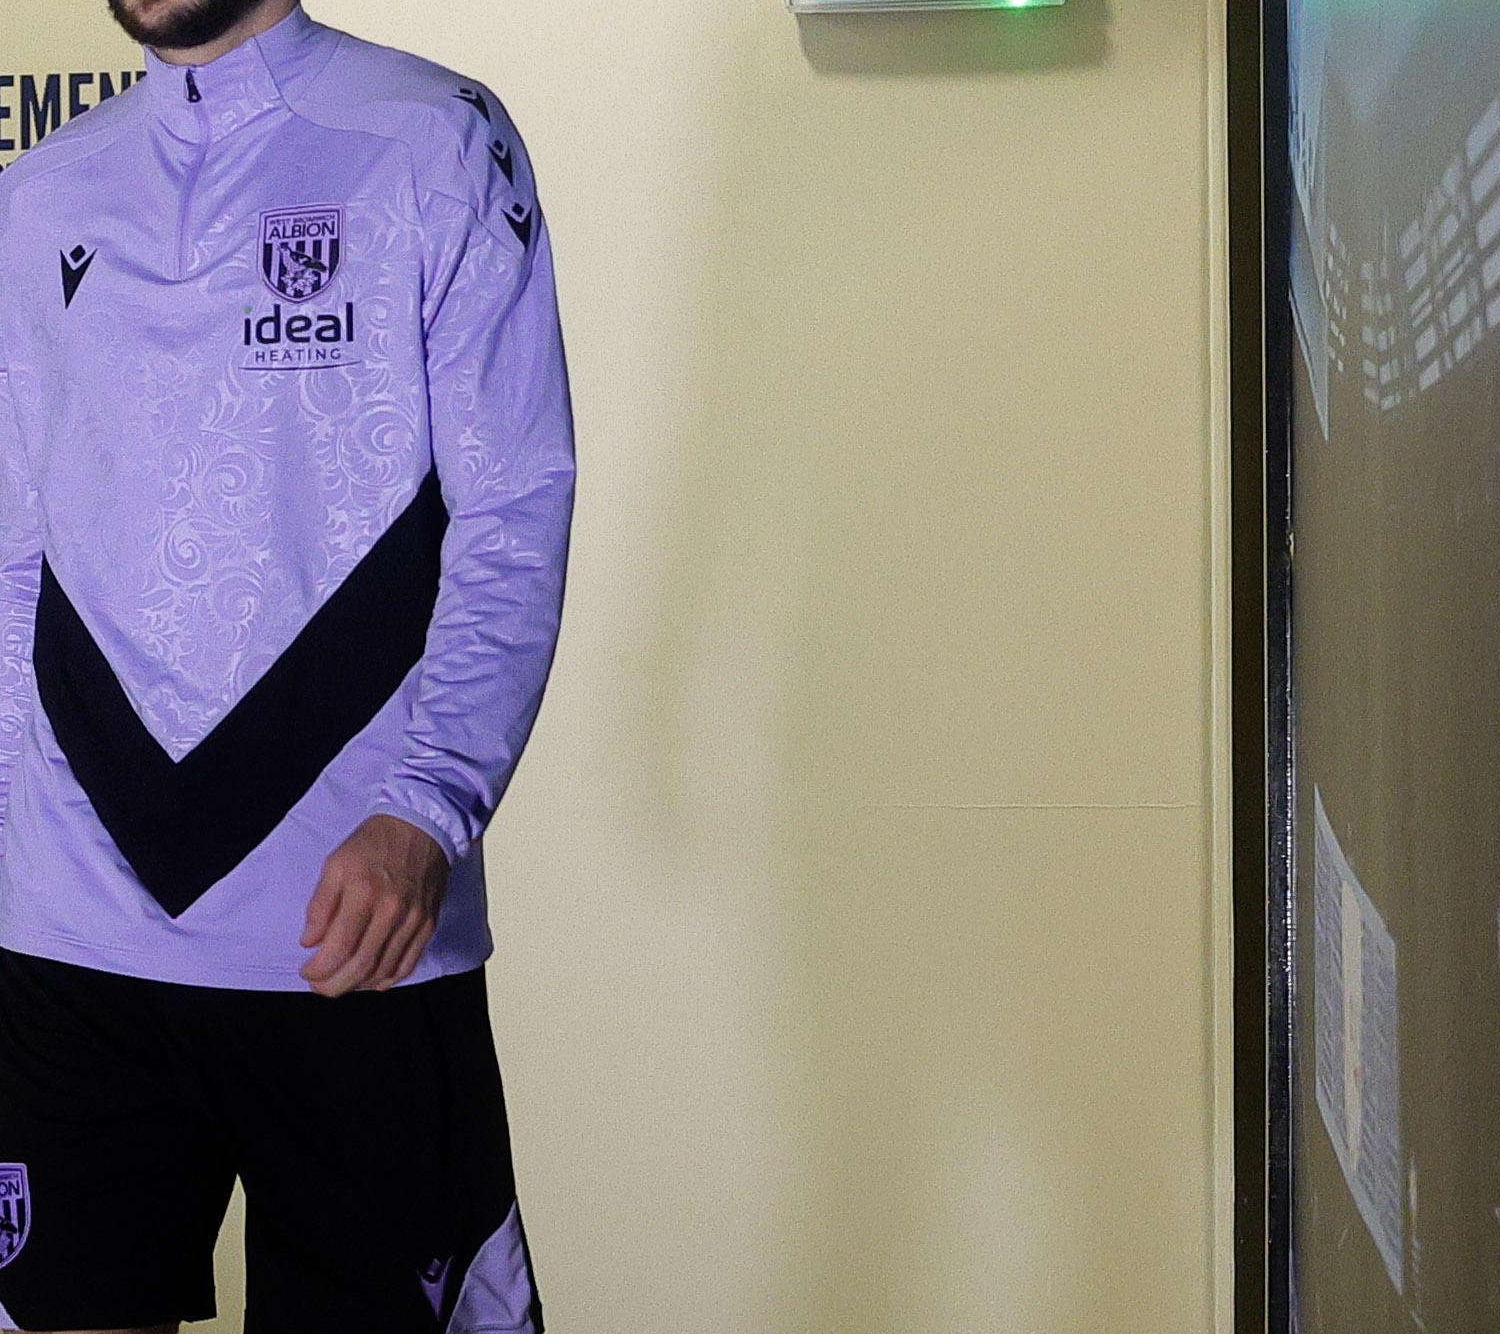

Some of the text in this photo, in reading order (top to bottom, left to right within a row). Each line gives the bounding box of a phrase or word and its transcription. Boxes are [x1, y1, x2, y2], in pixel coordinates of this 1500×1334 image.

[269, 221, 335, 240] ALBION
[244, 301, 354, 346] ideal
[254, 347, 342, 363] HEATING
